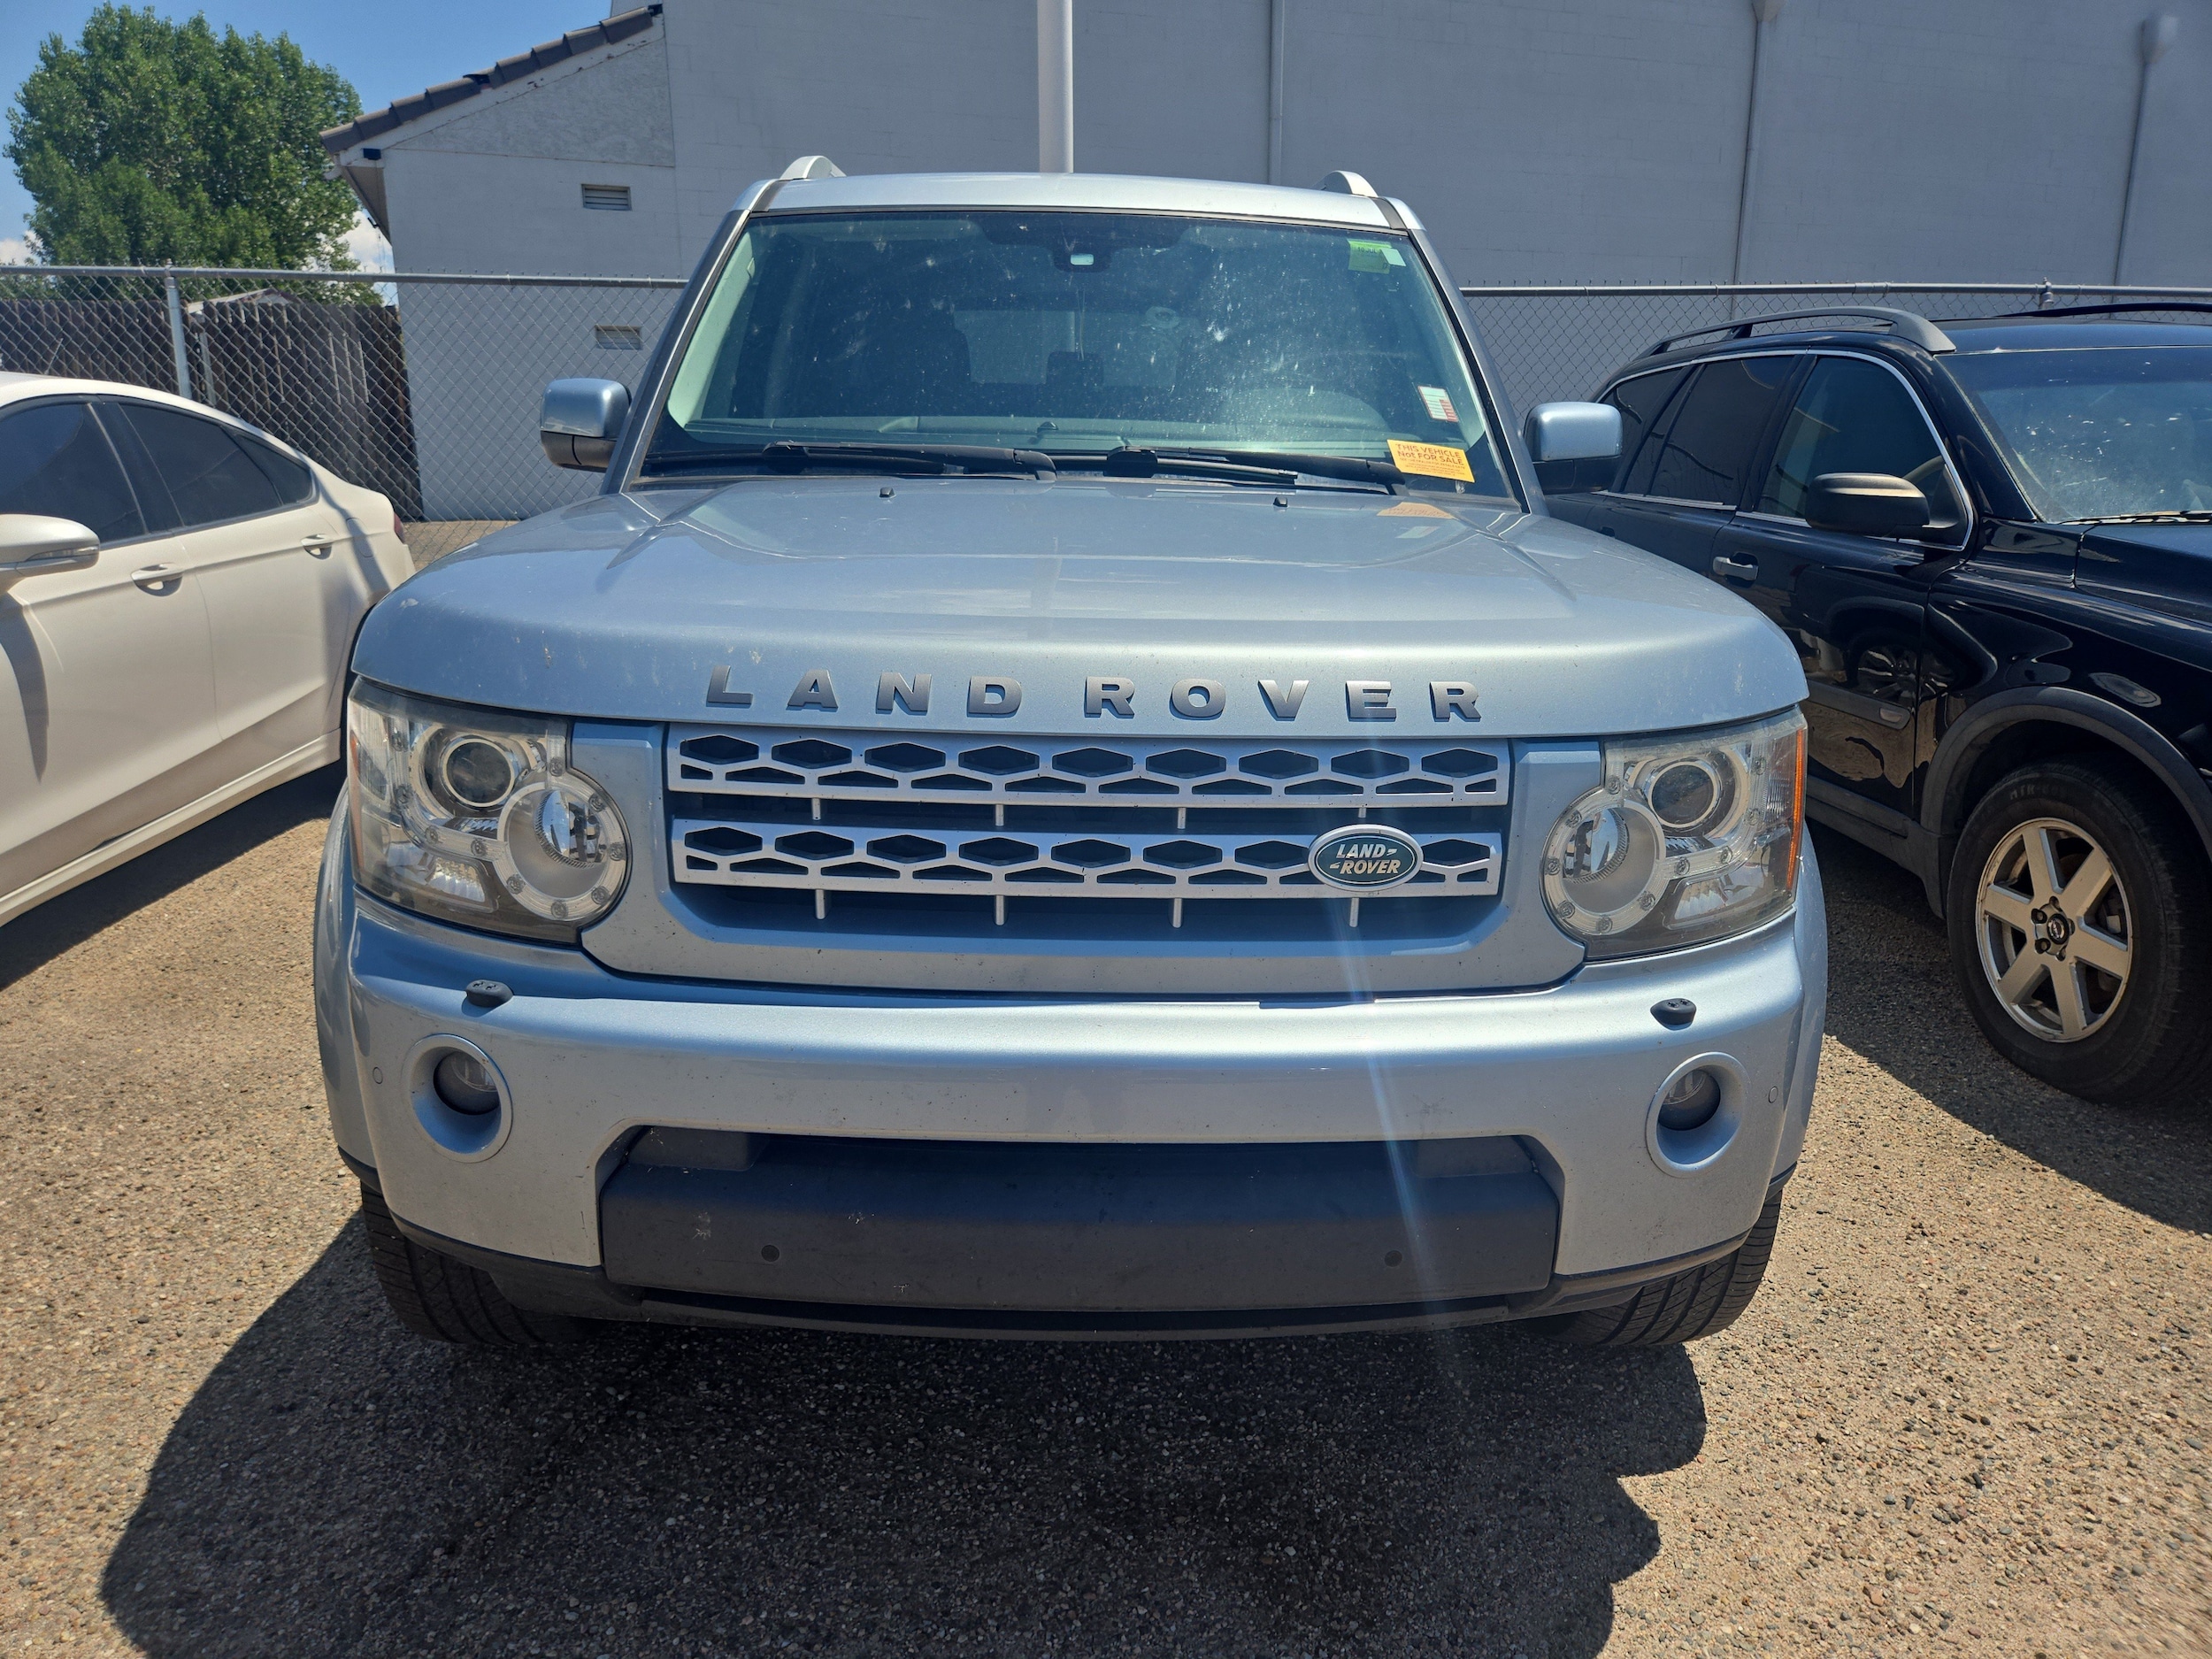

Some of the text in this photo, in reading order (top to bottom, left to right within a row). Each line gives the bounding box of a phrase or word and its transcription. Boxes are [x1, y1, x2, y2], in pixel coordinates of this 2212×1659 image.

[1395, 443, 1461, 458] THIS VEHICLE
[1417, 451, 1439, 461] FOR
[1440, 456, 1464, 465] SALE
[706, 665, 1482, 721] LAND ROVER
[1335, 843, 1386, 858] LAND
[1340, 859, 1402, 874] ROVER
